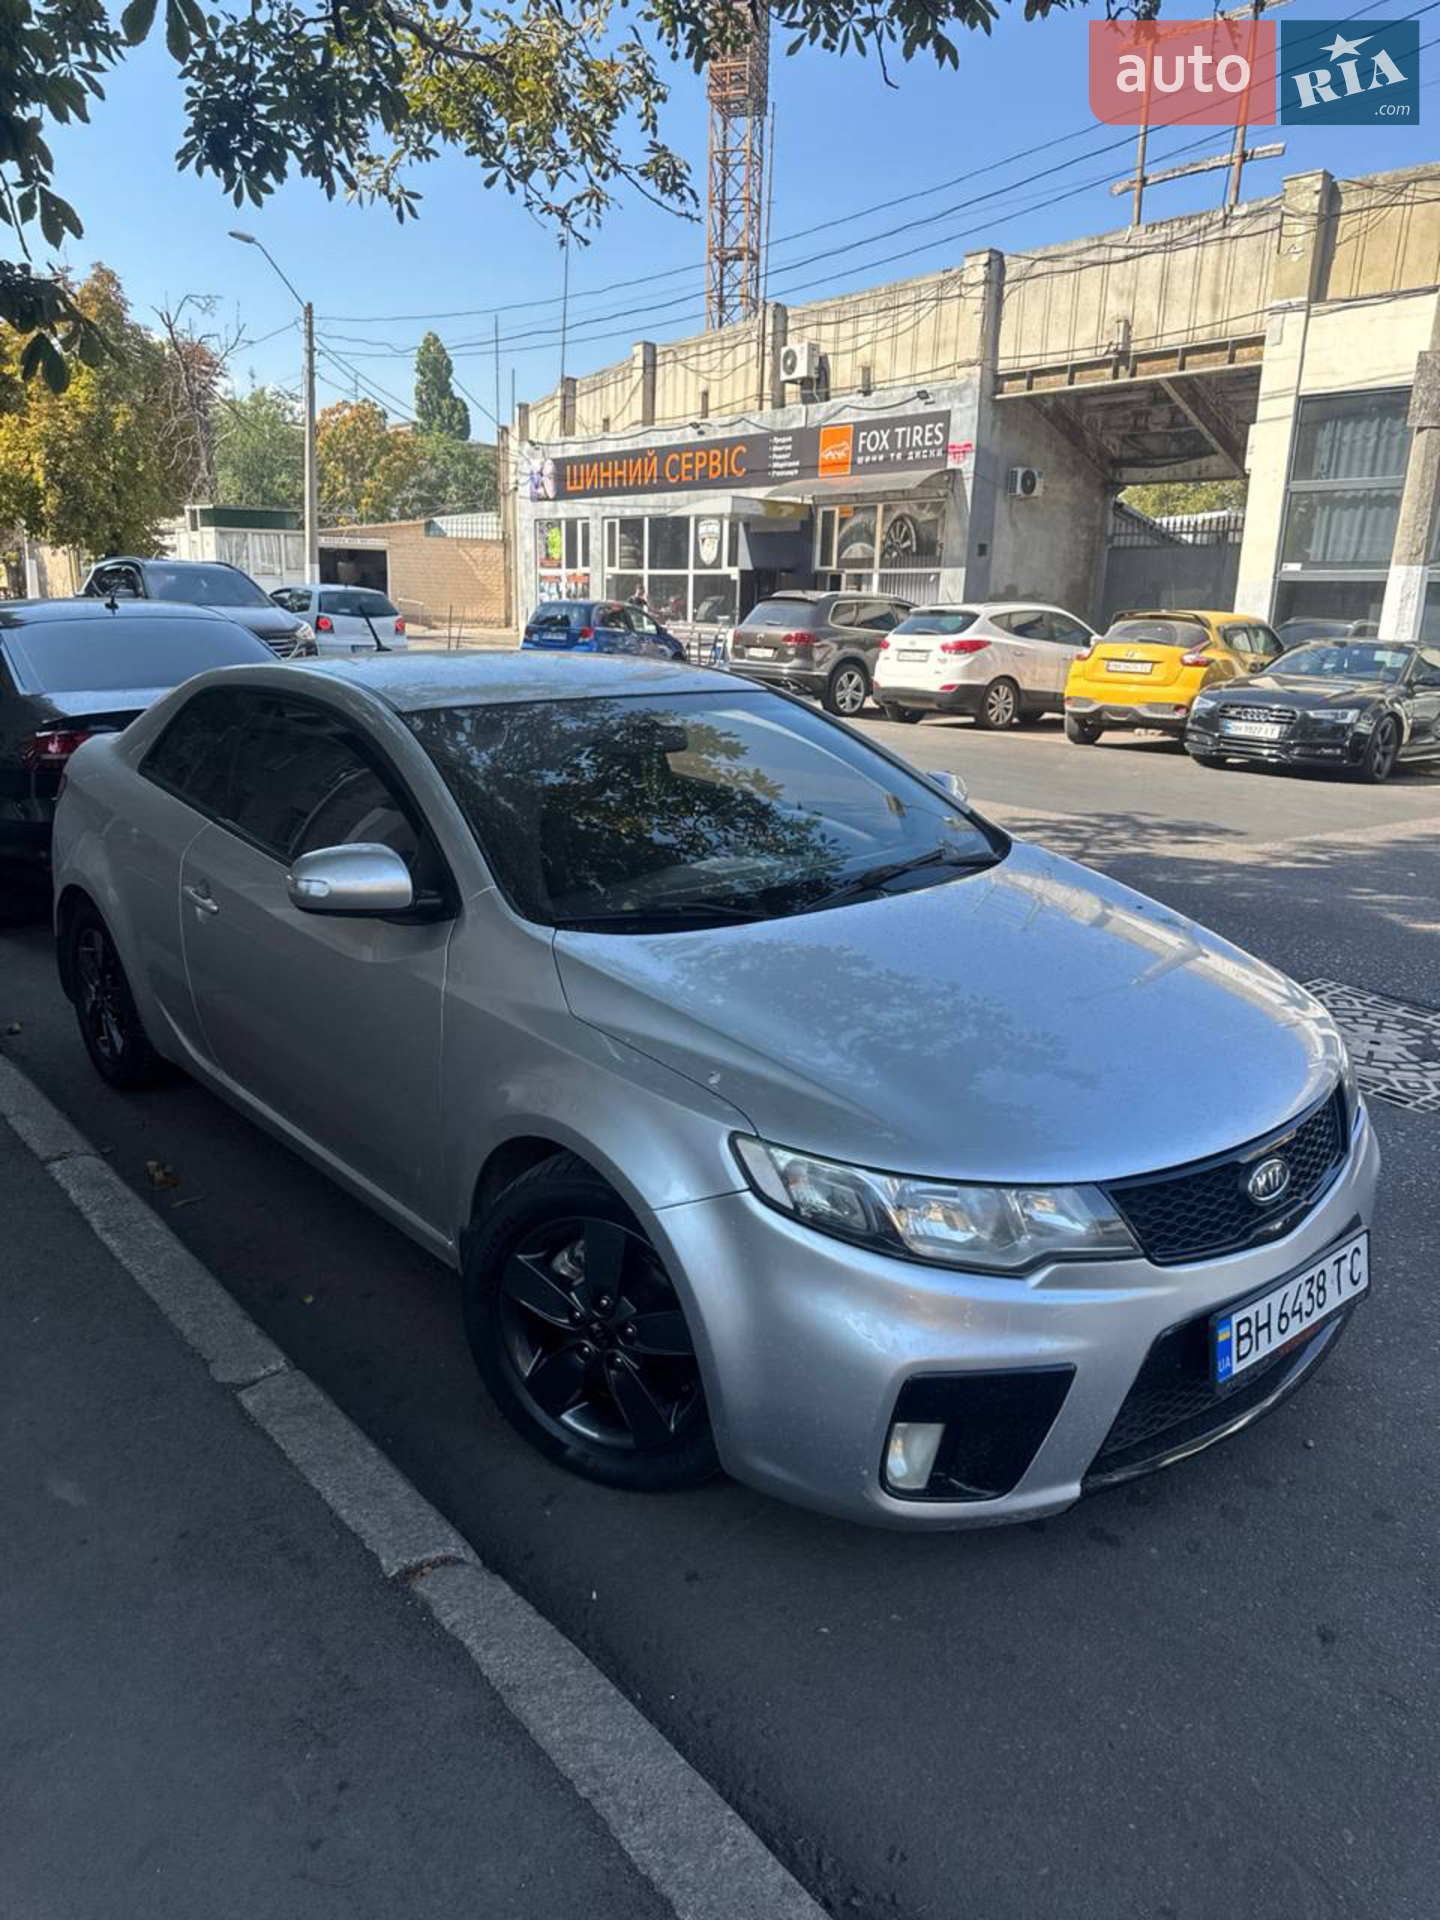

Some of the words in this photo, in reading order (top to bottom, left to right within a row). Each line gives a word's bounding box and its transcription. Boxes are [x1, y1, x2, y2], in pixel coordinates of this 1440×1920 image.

[858, 428, 891, 453] FOX
[895, 422, 945, 449] TIRES
[566, 449, 658, 493] ШИННИЙ
[665, 444, 748, 485] СЕРВІС
[1252, 1163, 1286, 1197] KIA
[1235, 1302, 1272, 1363] BH
[1277, 1269, 1328, 1335] 6438
[1332, 1246, 1362, 1296] TC
[1217, 1357, 1232, 1374] UA
